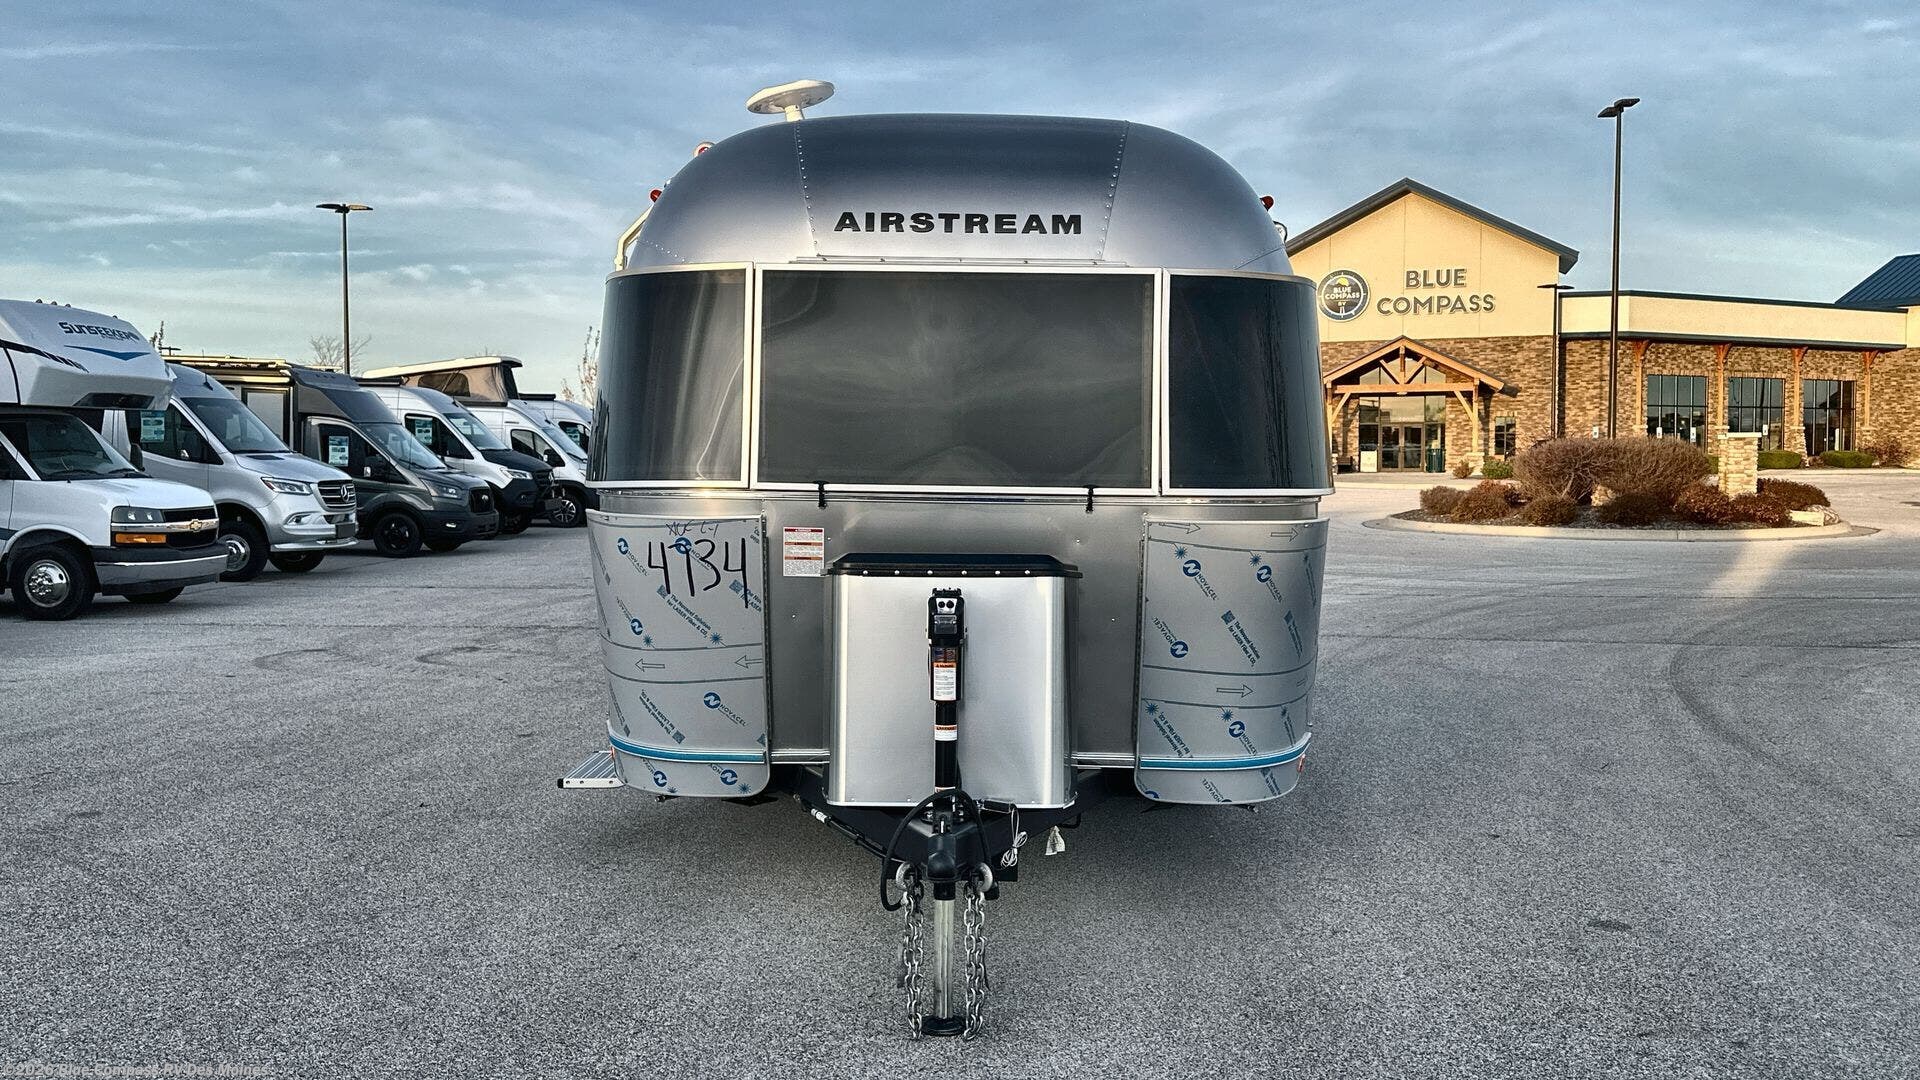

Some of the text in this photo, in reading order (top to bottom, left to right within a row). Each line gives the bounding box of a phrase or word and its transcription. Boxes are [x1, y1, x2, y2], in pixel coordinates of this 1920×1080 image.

[833, 211, 1082, 234] AIRSTREAM
[1333, 286, 1351, 294] BLUE
[1405, 268, 1467, 289] BLUE
[1324, 292, 1361, 300] COMPASS
[1376, 294, 1496, 316] COMPASS
[648, 538, 749, 609] 4734
[1197, 573, 1219, 600] NOVACEL
[1153, 617, 1174, 645] NOVACEL
[720, 704, 747, 727] NOVACEL
